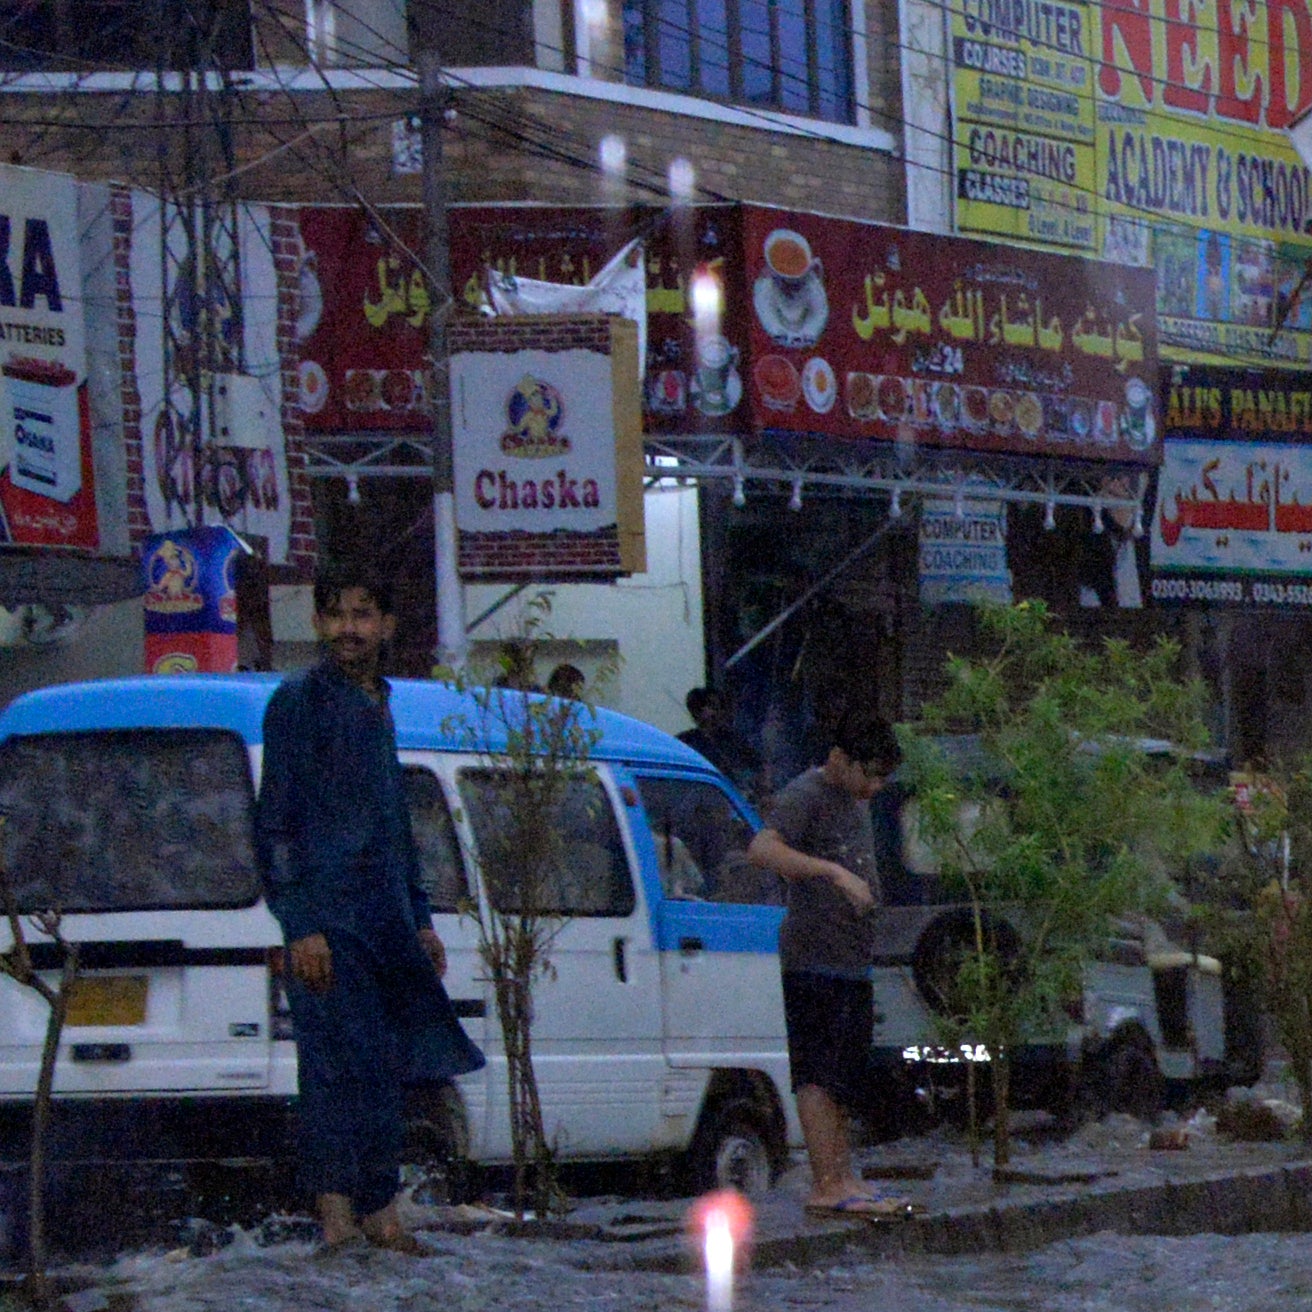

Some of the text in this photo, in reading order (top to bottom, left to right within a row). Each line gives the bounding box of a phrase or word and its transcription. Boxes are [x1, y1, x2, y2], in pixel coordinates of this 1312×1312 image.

[963, 0, 1083, 54] COMPUTER
[963, 40, 1026, 79] COURSES
[969, 127, 1076, 182] COACHING
[1106, 128, 1211, 218] ACADEMY
[1216, 145, 1232, 221] &
[966, 169, 1030, 209] CLASSES
[473, 467, 600, 511] Chaska
[921, 517, 998, 541] COMPUTER
